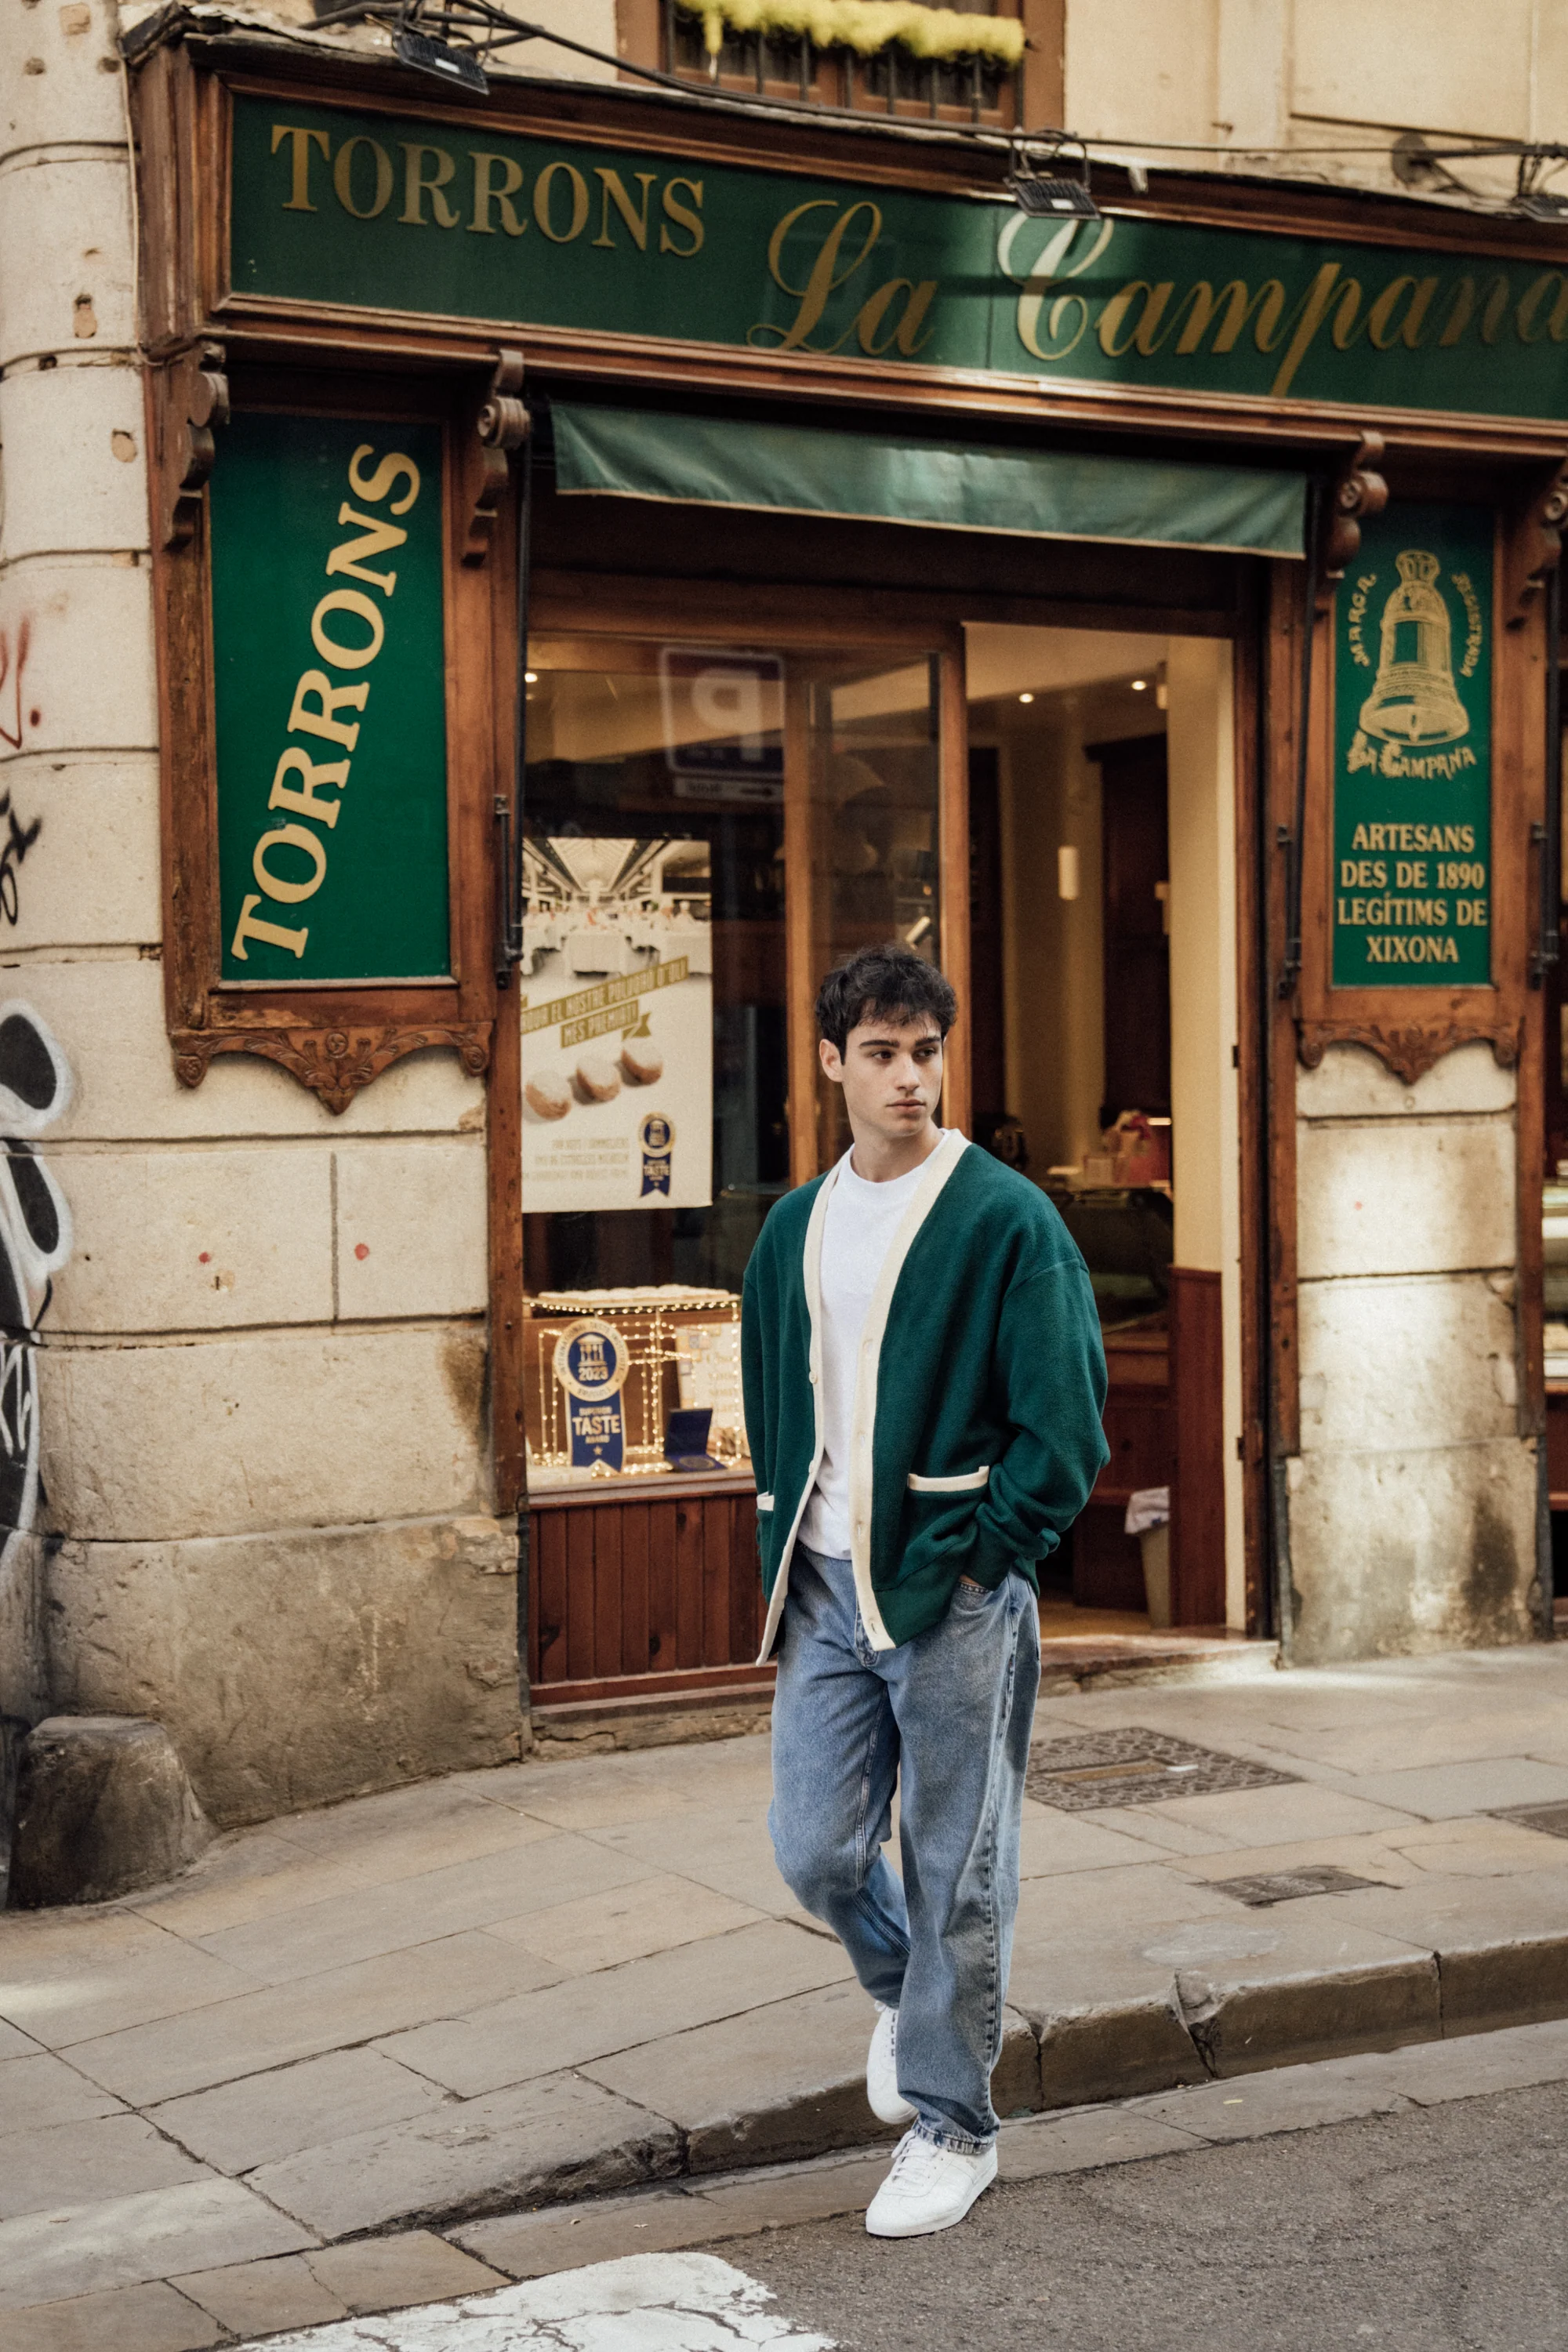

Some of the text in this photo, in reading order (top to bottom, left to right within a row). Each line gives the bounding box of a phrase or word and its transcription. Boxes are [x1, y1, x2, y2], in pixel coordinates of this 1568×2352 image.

[271, 125, 705, 257] TORRONS
[746, 199, 938, 357] La
[230, 444, 421, 961] TORRONS
[1352, 823, 1475, 853] ARTESANS
[1340, 860, 1486, 890] DES DE 1890
[1338, 891, 1487, 927] LEGÍTIMS DE
[1366, 935, 1460, 964] XIXONA
[572, 1414, 621, 1436] TASTE
